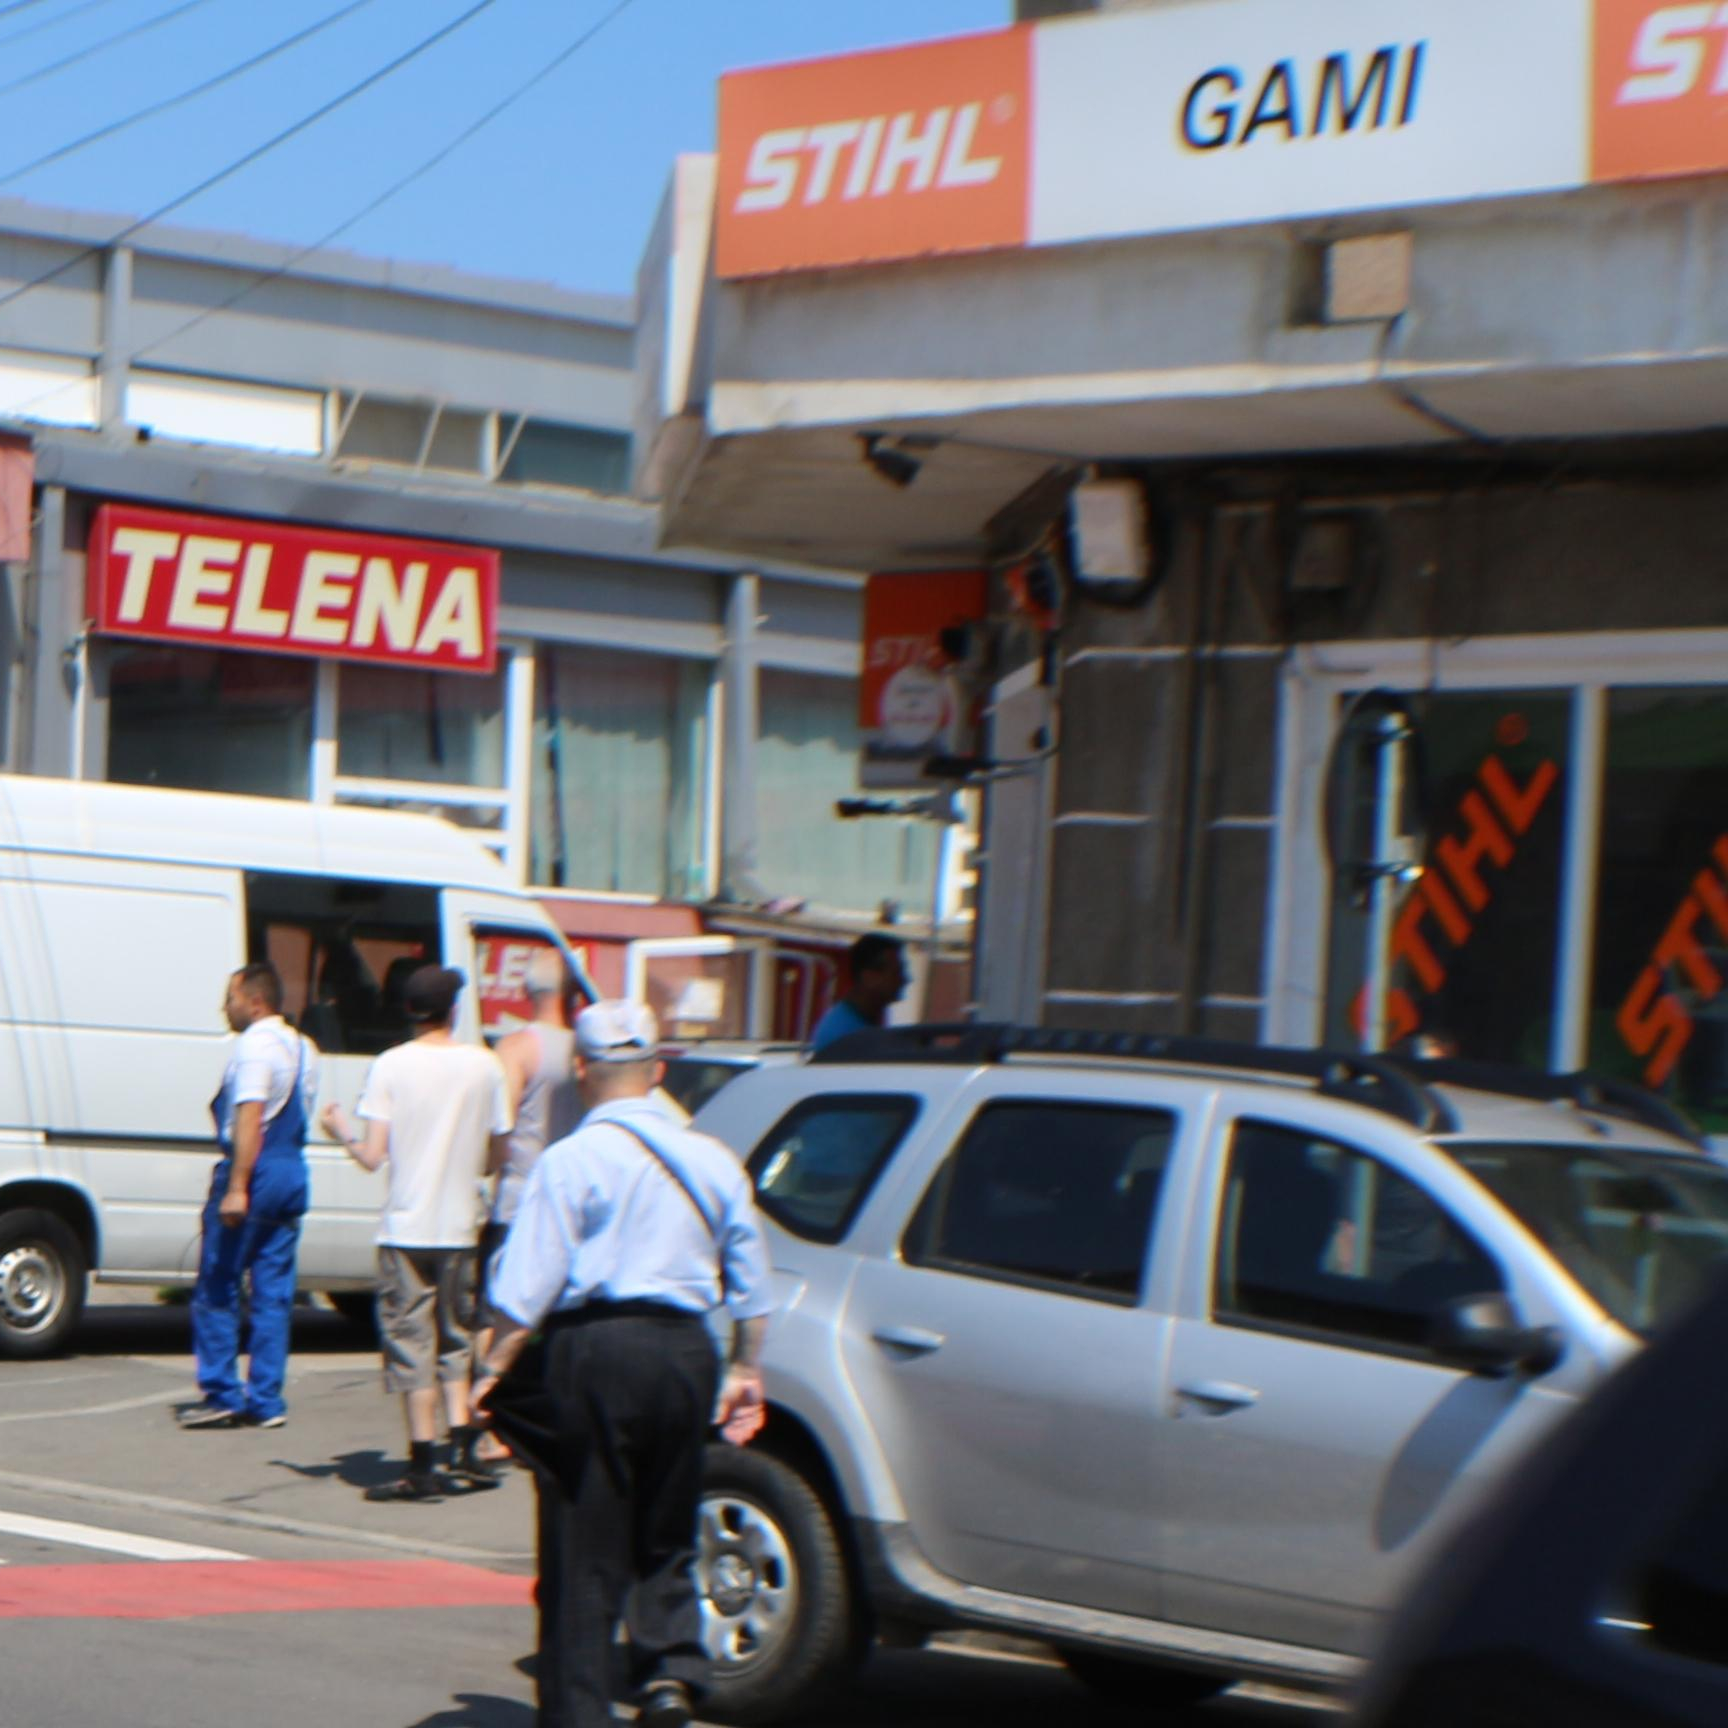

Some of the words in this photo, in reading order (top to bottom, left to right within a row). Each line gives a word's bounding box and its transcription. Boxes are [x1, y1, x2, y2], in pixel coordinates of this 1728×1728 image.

[1180, 40, 1428, 150] GAMI
[733, 101, 1002, 214] STIHL
[111, 527, 483, 658] TELENA
